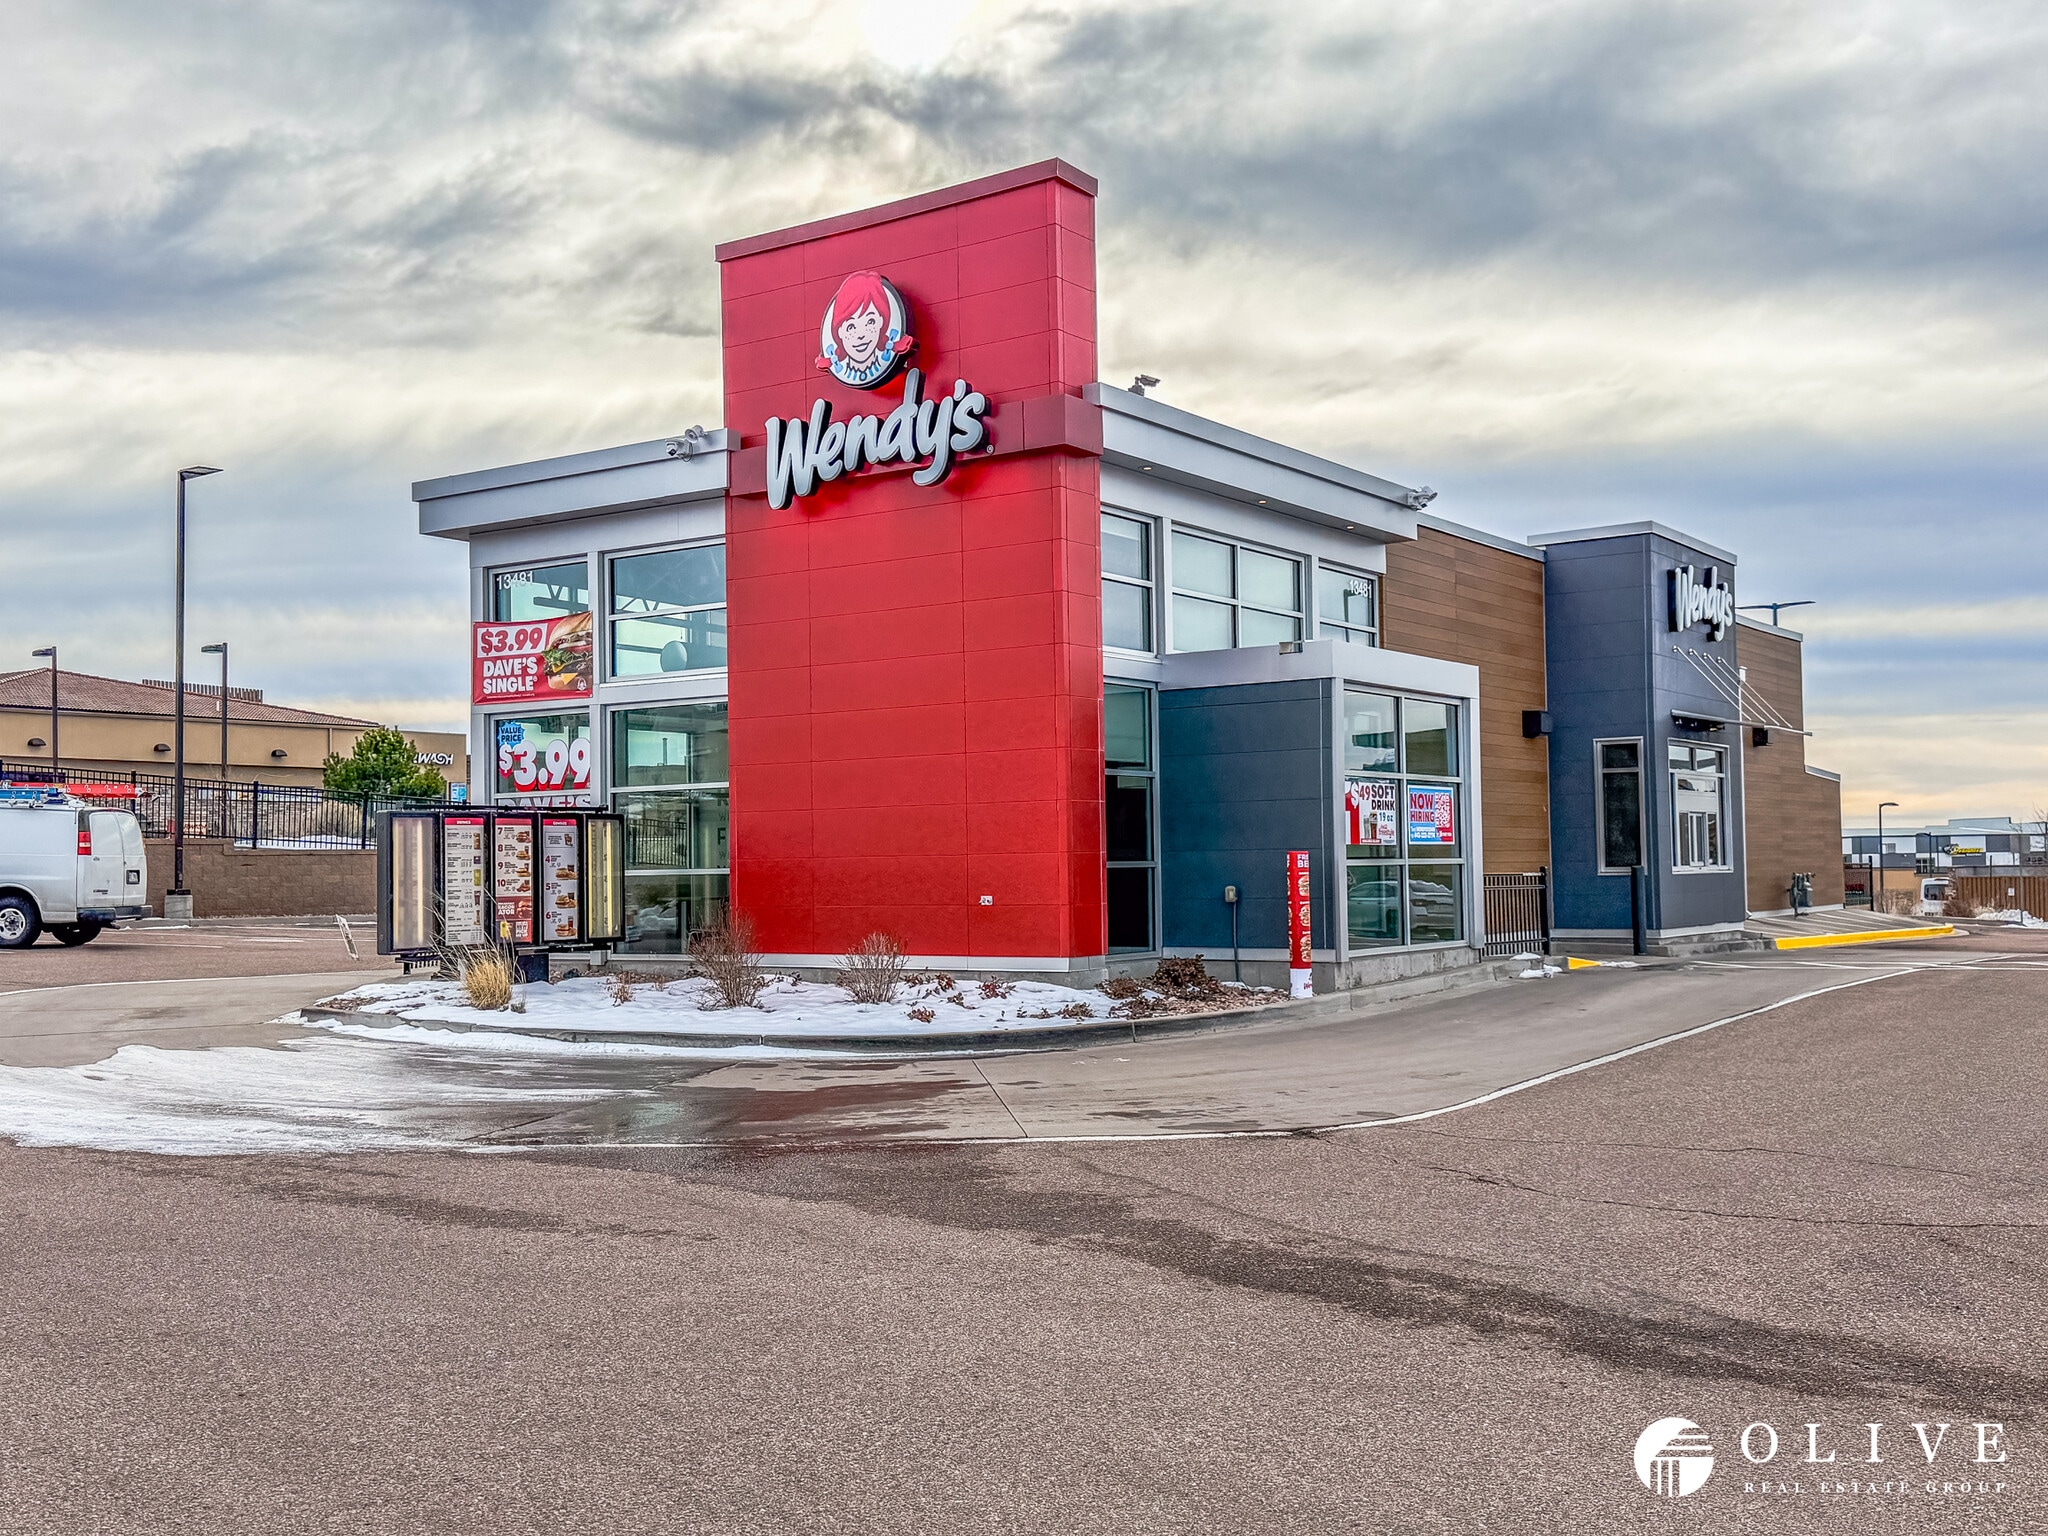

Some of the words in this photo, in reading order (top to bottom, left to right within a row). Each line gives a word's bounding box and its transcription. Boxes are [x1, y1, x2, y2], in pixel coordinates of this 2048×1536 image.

[764, 367, 986, 510] Wendy's
[496, 571, 533, 590] 13481
[1349, 579, 1372, 599] 13481
[1674, 564, 1733, 642] Wendy's
[480, 627, 543, 656] $3.99
[483, 656, 538, 677] DAVE'S
[500, 726, 522, 735] VALUE
[501, 734, 522, 742] PRICE
[499, 737, 591, 785] $3.99
[1371, 784, 1395, 799] SOFT
[1371, 799, 1395, 811] DRINK
[1410, 793, 1434, 809] NOW
[1410, 811, 1435, 822] HIRING
[497, 844, 503, 852] 8
[497, 861, 504, 869] 9
[497, 879, 506, 887] 10
